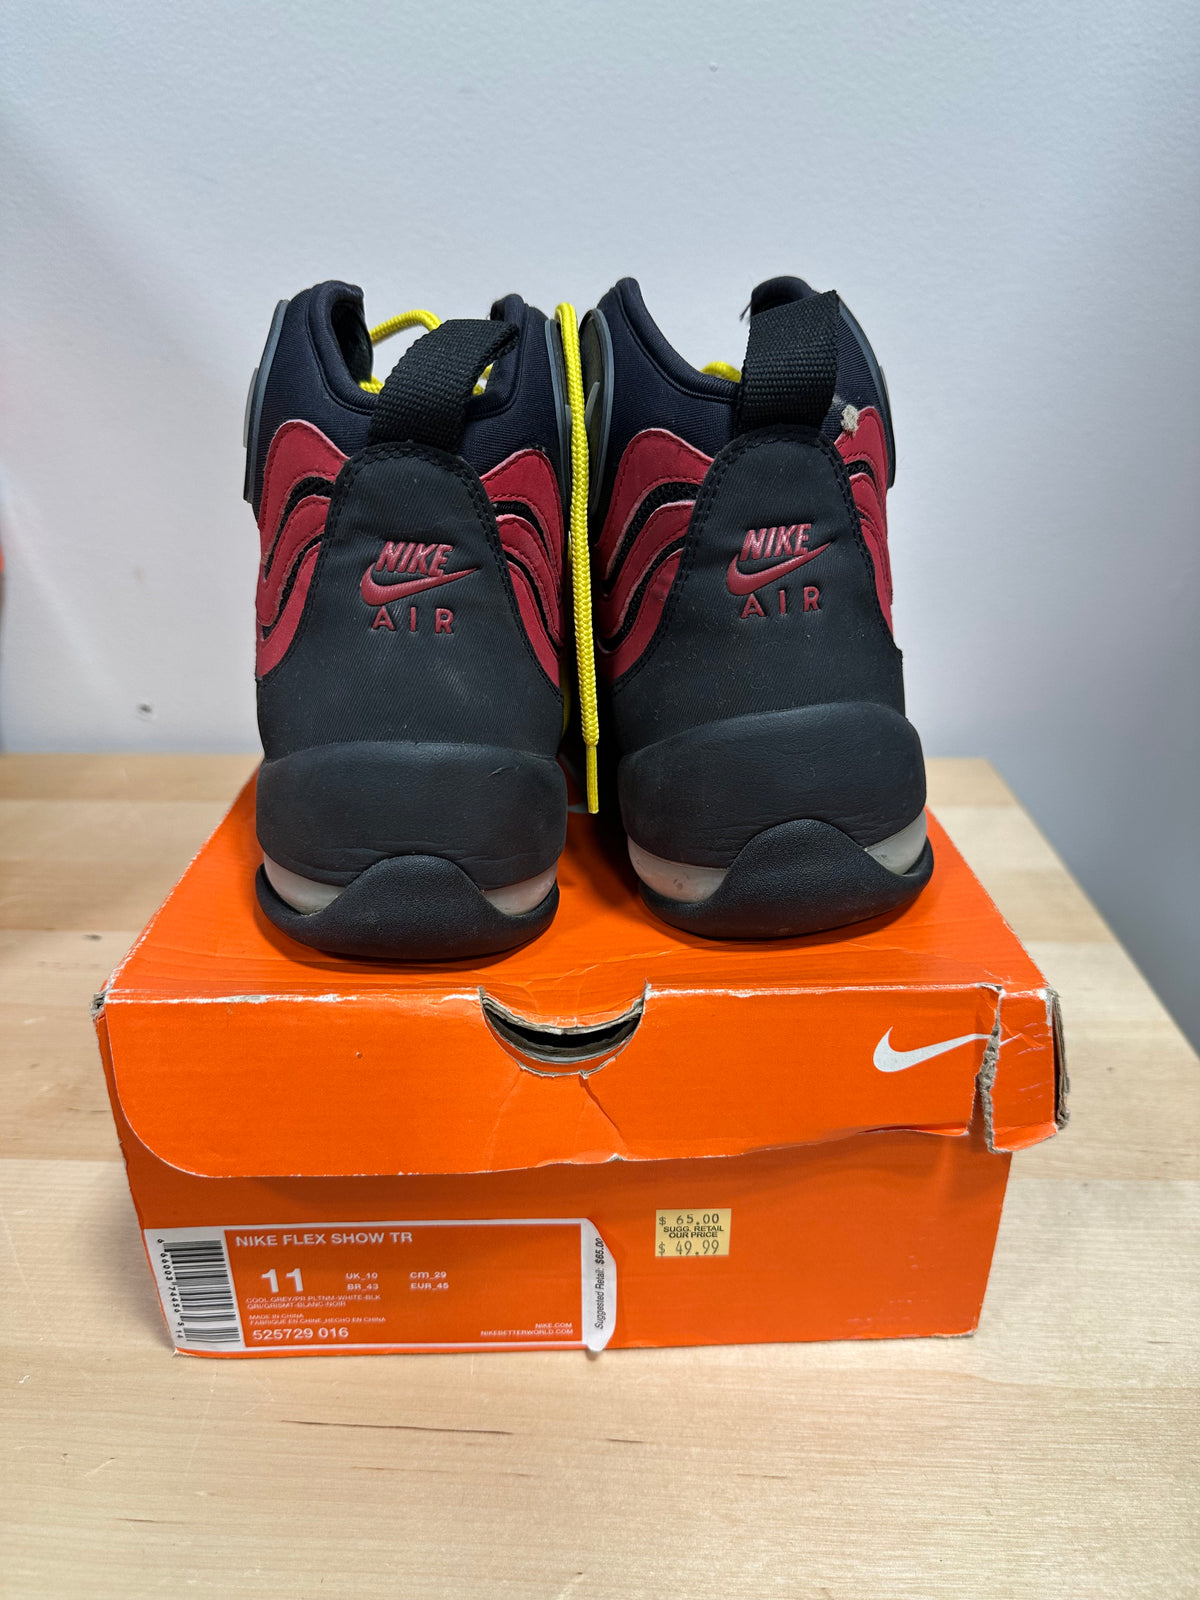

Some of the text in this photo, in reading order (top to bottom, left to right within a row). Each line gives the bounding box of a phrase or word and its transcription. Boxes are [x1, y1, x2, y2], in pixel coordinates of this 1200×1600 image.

[740, 523, 812, 560] NIKE
[375, 541, 454, 577] NIKE
[741, 586, 821, 620] AIR
[372, 606, 454, 635] AIR
[659, 1213, 720, 1226] $ 65.00
[663, 1225, 724, 1233] SUGG. RETAIL
[235, 1231, 413, 1247] NIKE FLEX SHOW TR
[690, 1231, 718, 1239] PRICE
[658, 1240, 720, 1256] $ 49.99
[261, 1268, 304, 1294] 11
[594, 1237, 606, 1330] Suggested Retail: $65.00
[252, 1327, 349, 1340] 525729 016
